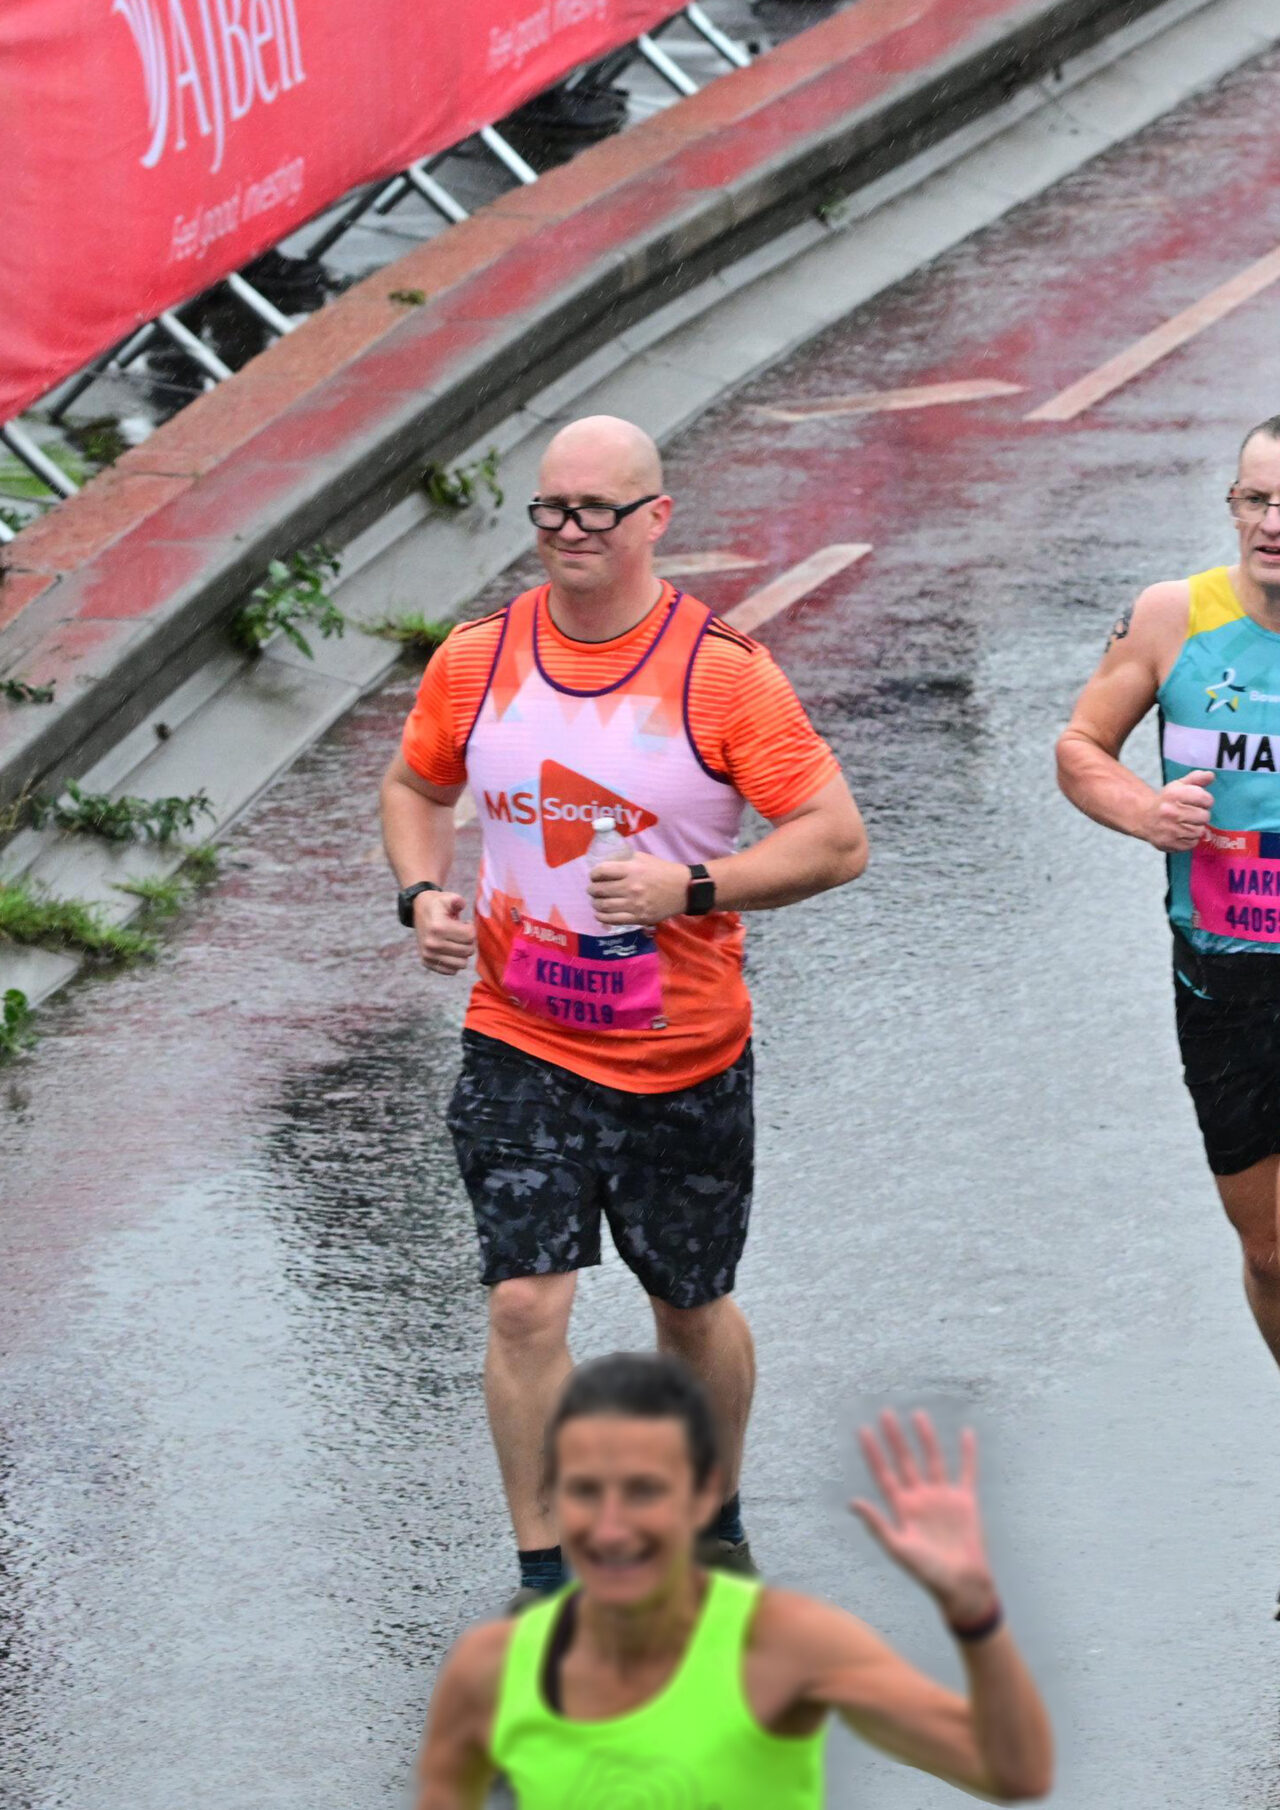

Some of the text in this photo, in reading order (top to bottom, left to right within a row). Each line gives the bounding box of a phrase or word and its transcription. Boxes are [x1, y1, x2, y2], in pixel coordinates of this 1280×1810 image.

[483, 790, 643, 831] MS Society
[536, 957, 624, 994] KENNETH
